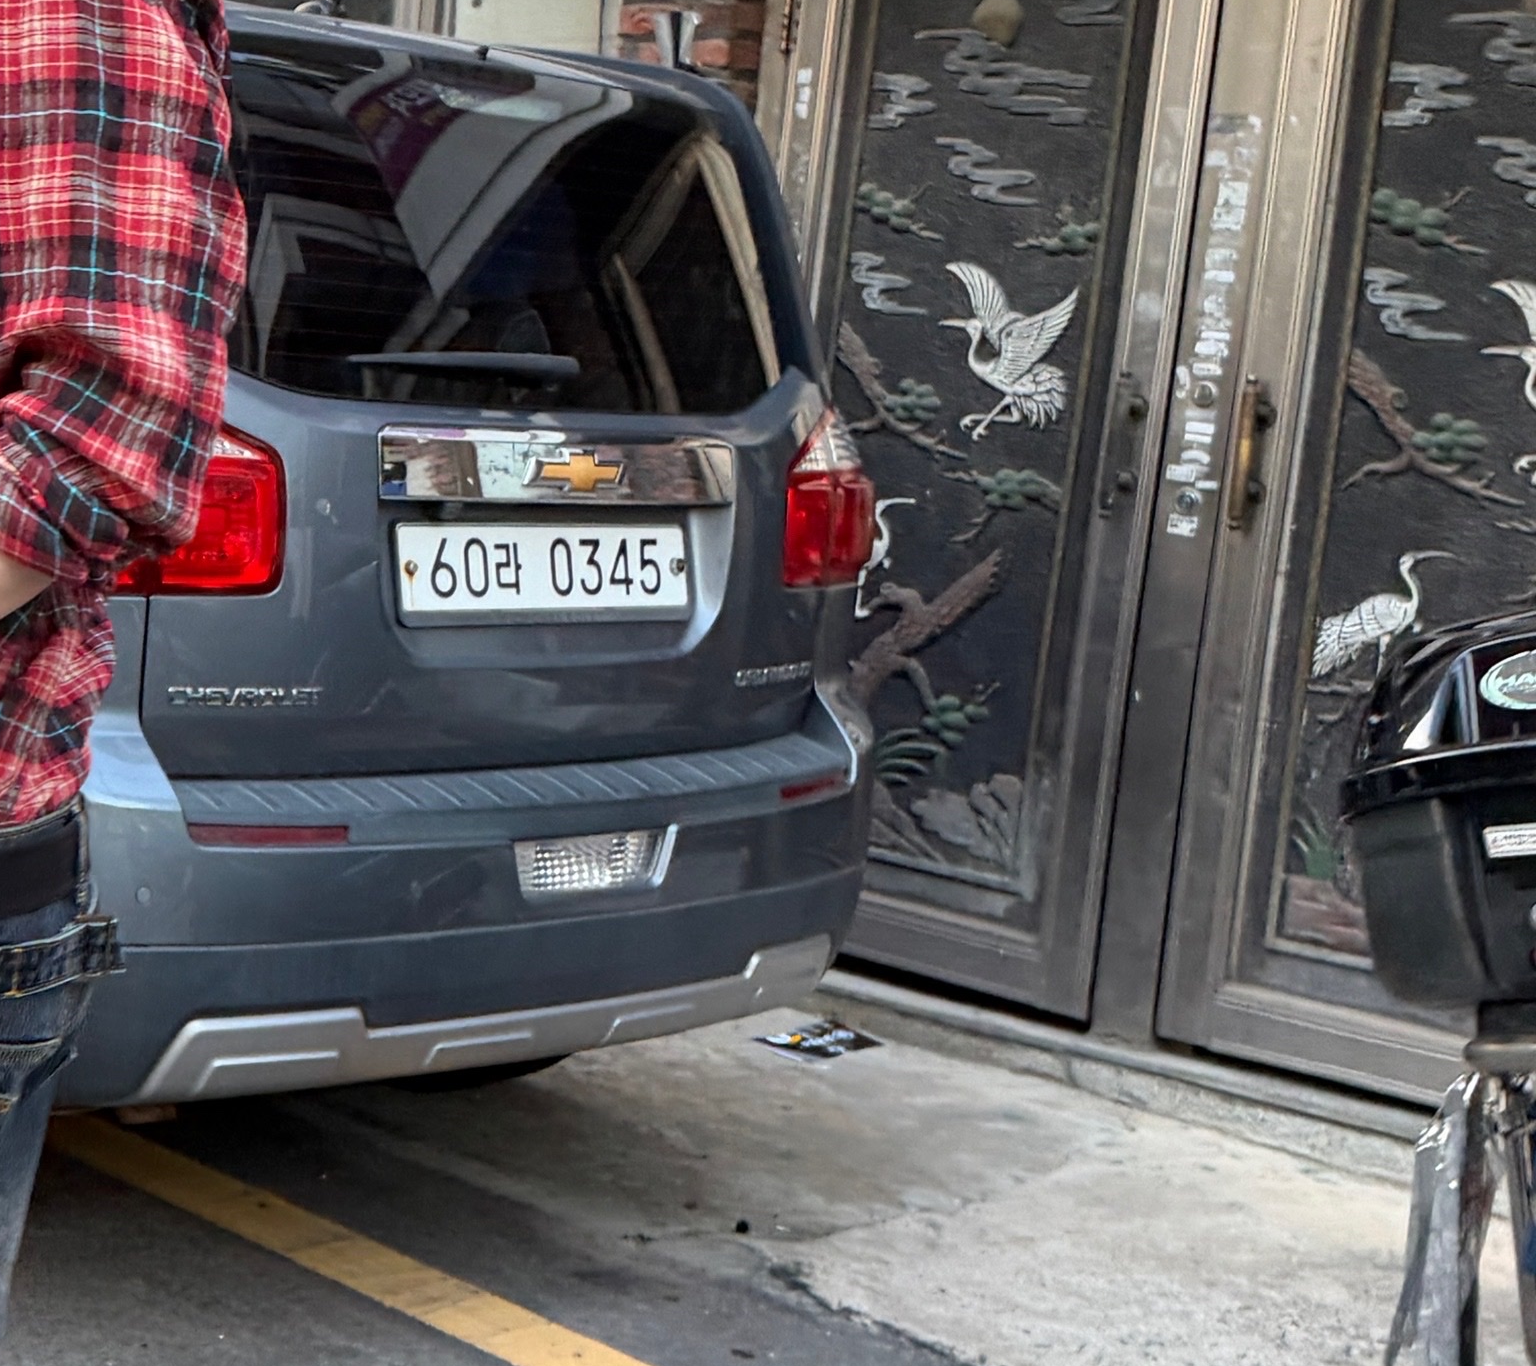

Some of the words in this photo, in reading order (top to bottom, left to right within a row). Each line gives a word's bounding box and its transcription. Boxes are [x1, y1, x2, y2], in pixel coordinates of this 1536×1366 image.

[430, 537, 522, 598] 60라
[550, 537, 661, 596] 0345
[167, 686, 324, 707] CHEVROLET
